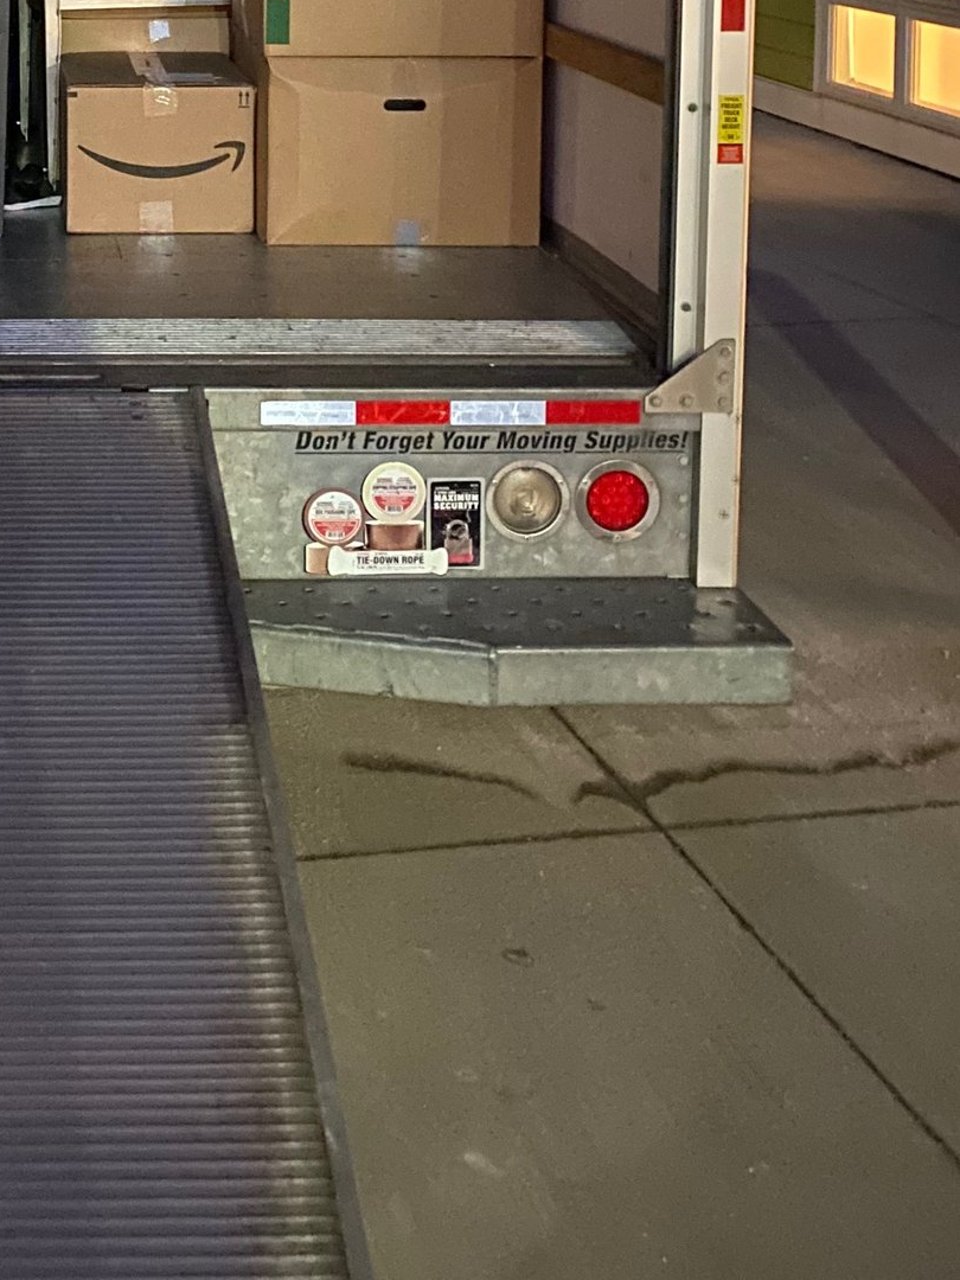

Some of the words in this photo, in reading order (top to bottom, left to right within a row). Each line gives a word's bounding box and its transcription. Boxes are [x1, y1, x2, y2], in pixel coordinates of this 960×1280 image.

[295, 431, 356, 451] Don't
[362, 431, 435, 453] Forget
[442, 431, 490, 450] Your
[496, 431, 577, 452] Moving
[584, 430, 690, 452] Supplies!
[434, 494, 479, 502] MAXIMUM
[434, 502, 478, 510] SECURITY
[357, 556, 399, 565] TIE-DOWN
[401, 556, 425, 564] ROPE
